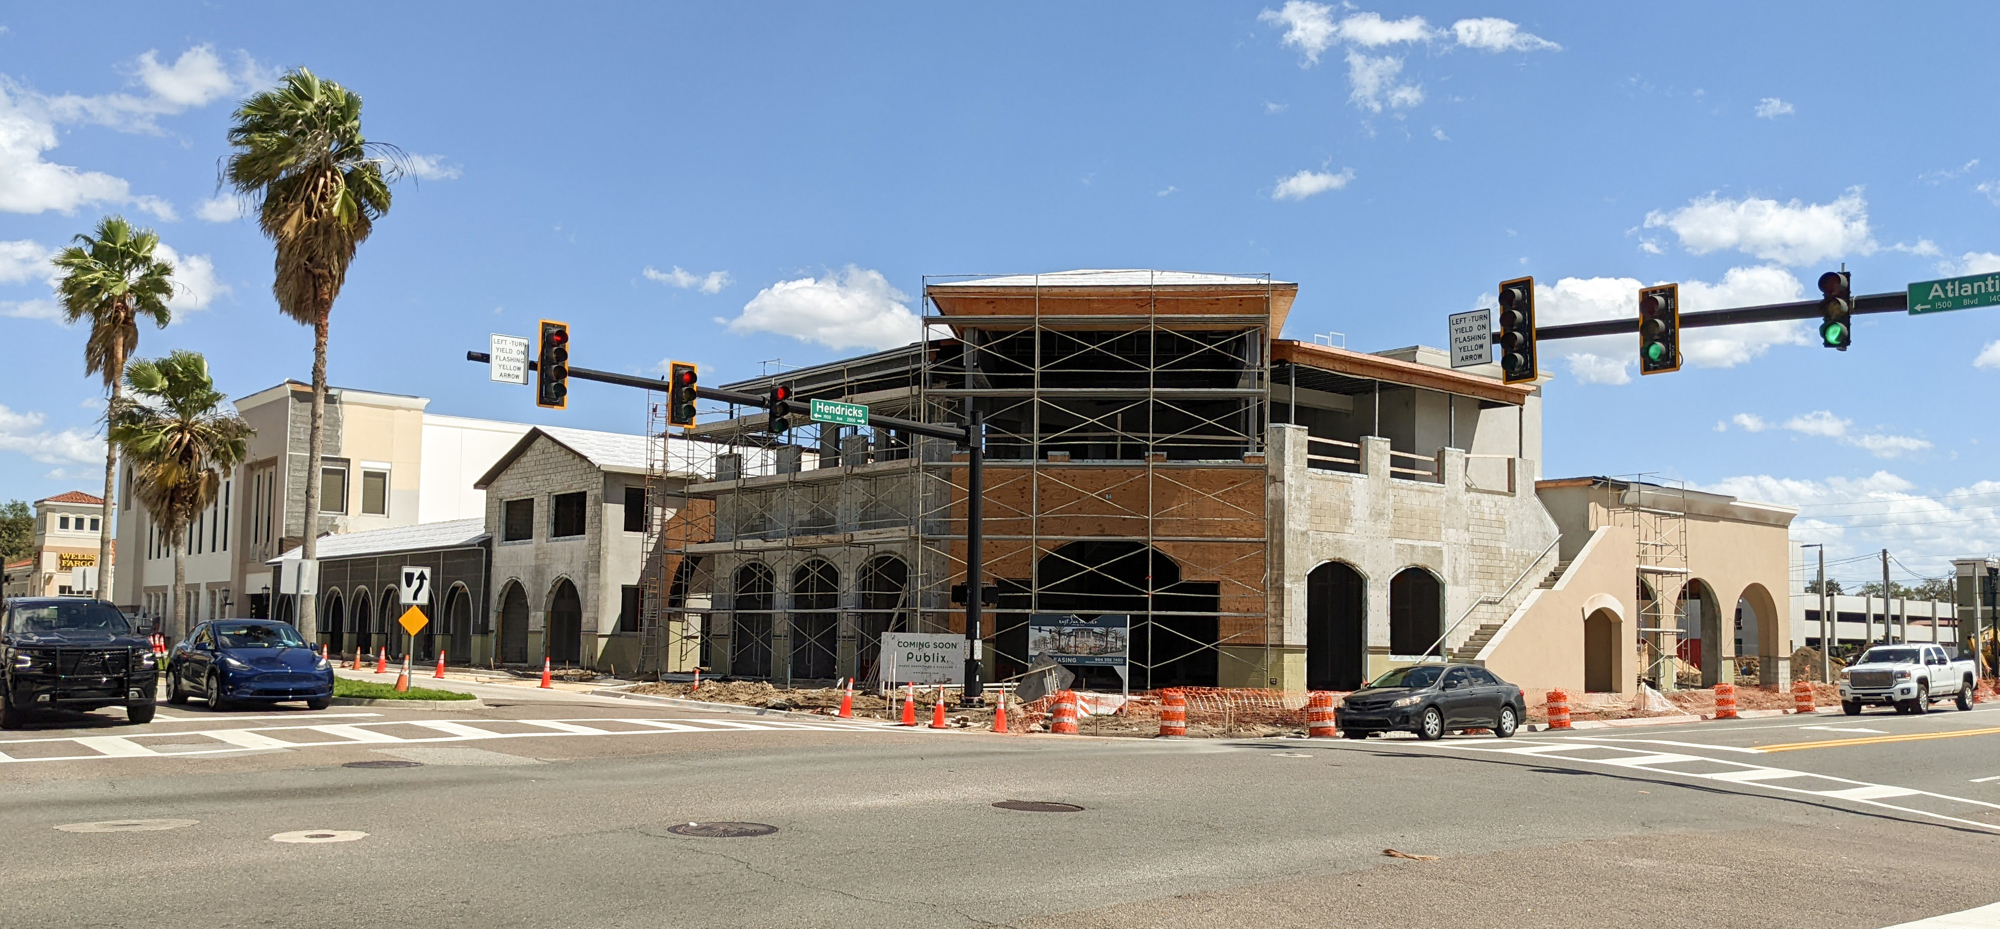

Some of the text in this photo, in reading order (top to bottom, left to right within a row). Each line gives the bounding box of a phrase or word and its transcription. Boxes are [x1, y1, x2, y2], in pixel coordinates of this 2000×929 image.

[1935, 301, 1952, 309] 1500
[1963, 298, 1978, 306] Blvd
[1454, 326, 1473, 334] YIELD
[1455, 333, 1486, 344] FLASHING
[1458, 343, 1484, 353] YELLOW
[495, 355, 525, 363] FLASHING
[1460, 353, 1483, 362] ARROW
[498, 364, 522, 372] YELLOW
[816, 401, 863, 418] Hendricks
[61, 552, 96, 560] WELLS
[61, 559, 95, 567] FARGO
[897, 641, 931, 649] COMING
[933, 641, 957, 649] SOON
